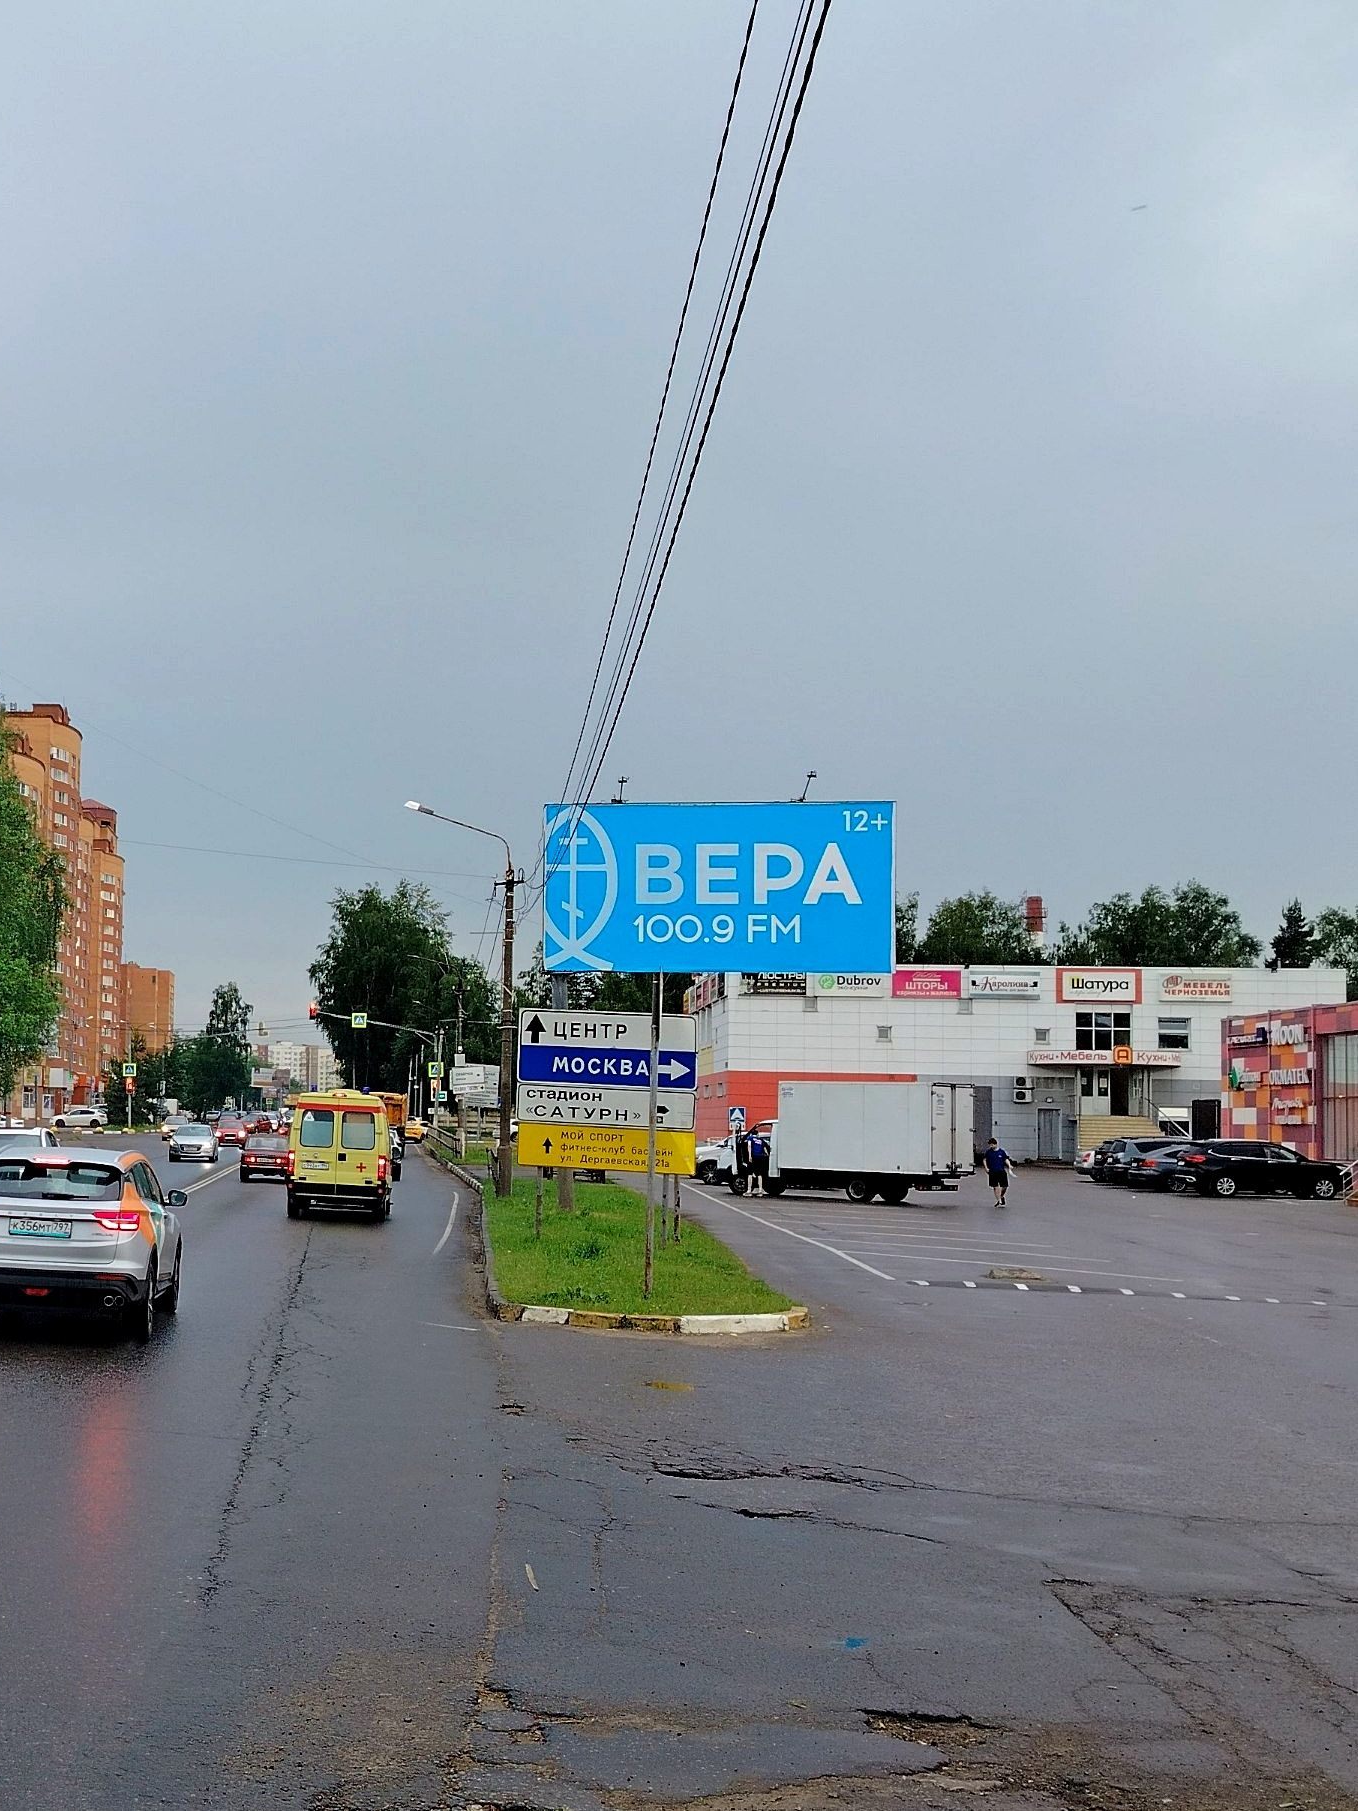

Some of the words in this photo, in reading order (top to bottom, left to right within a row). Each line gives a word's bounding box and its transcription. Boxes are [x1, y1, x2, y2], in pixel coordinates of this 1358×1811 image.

[842, 810, 888, 832] 12+
[635, 842, 863, 905] ВЕРА
[632, 913, 735, 943] 100.9
[747, 913, 801, 943] FM
[757, 971, 805, 980] ЛЮСТРЫ
[837, 974, 881, 986] Dubrov
[905, 981, 948, 990] ШТОРЫ
[1071, 977, 1129, 992] Шатура
[554, 1021, 628, 1040] ЦЕНТР
[1029, 1052, 1054, 1063] Кухни
[1060, 1051, 1108, 1061] Мебель
[1137, 1052, 1167, 1064] Кухни
[552, 1056, 649, 1077] МОСКВА
[1269, 1068, 1309, 1085] ORMATEK
[526, 1089, 603, 1102] стадион
[560, 1130, 584, 1141] МОЙ
[589, 1132, 625, 1143] СПОРТ
[560, 1143, 626, 1155] фитнес-клуб
[631, 1146, 673, 1157] басейн
[560, 1155, 574, 1164] ул.
[655, 1158, 670, 1168] 21а
[53, 1222, 69, 1231] 797
